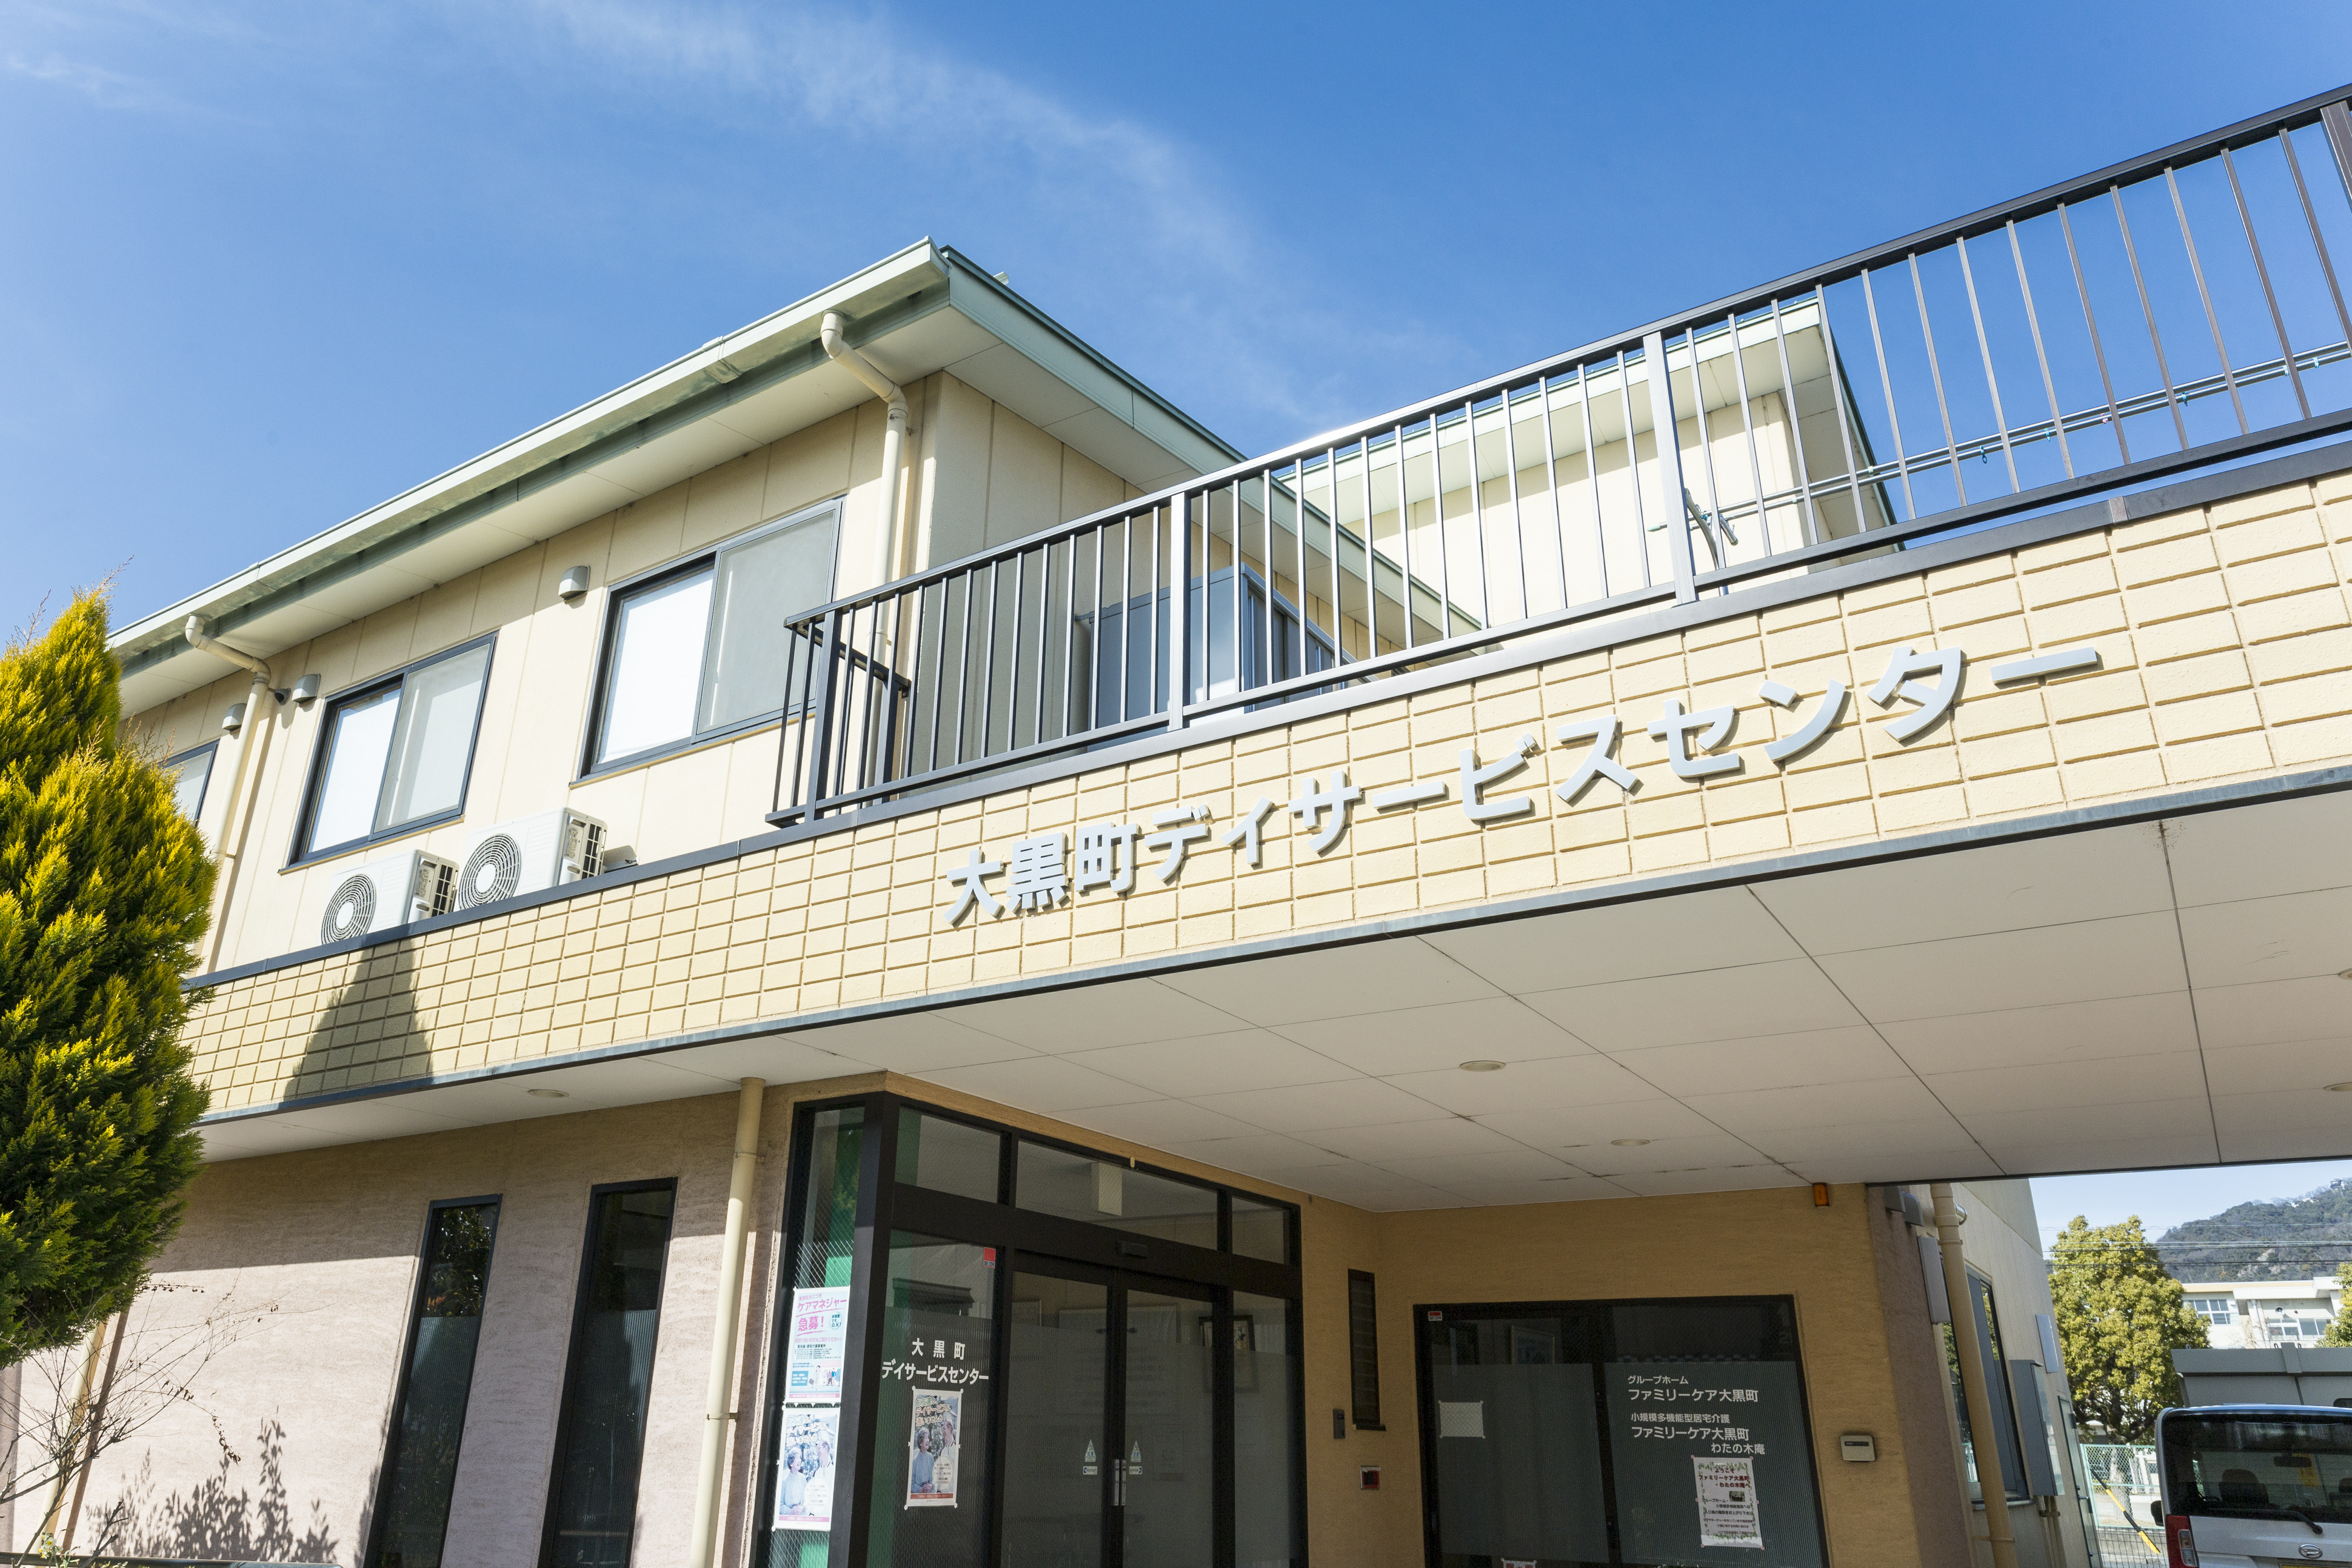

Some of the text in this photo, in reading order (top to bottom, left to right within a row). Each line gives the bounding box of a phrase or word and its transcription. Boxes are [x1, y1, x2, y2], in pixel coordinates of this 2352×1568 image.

[943, 646, 2099, 926] 大黒町ディサービスセンター
[798, 1298, 847, 1312] ケアマネジャー
[798, 1315, 824, 1332] 急募！
[911, 1337, 966, 1360] 大黒町
[881, 1358, 989, 1386] デイサービスセンター
[1628, 1375, 1689, 1384] グループホーム
[1628, 1388, 1759, 1403] ファミリーケア大黒町
[1631, 1412, 1731, 1424] 小規模多機能型居宅介護
[1631, 1426, 1749, 1441] ファミリーケア大黒町
[1711, 1443, 1765, 1455] わたの木庵
